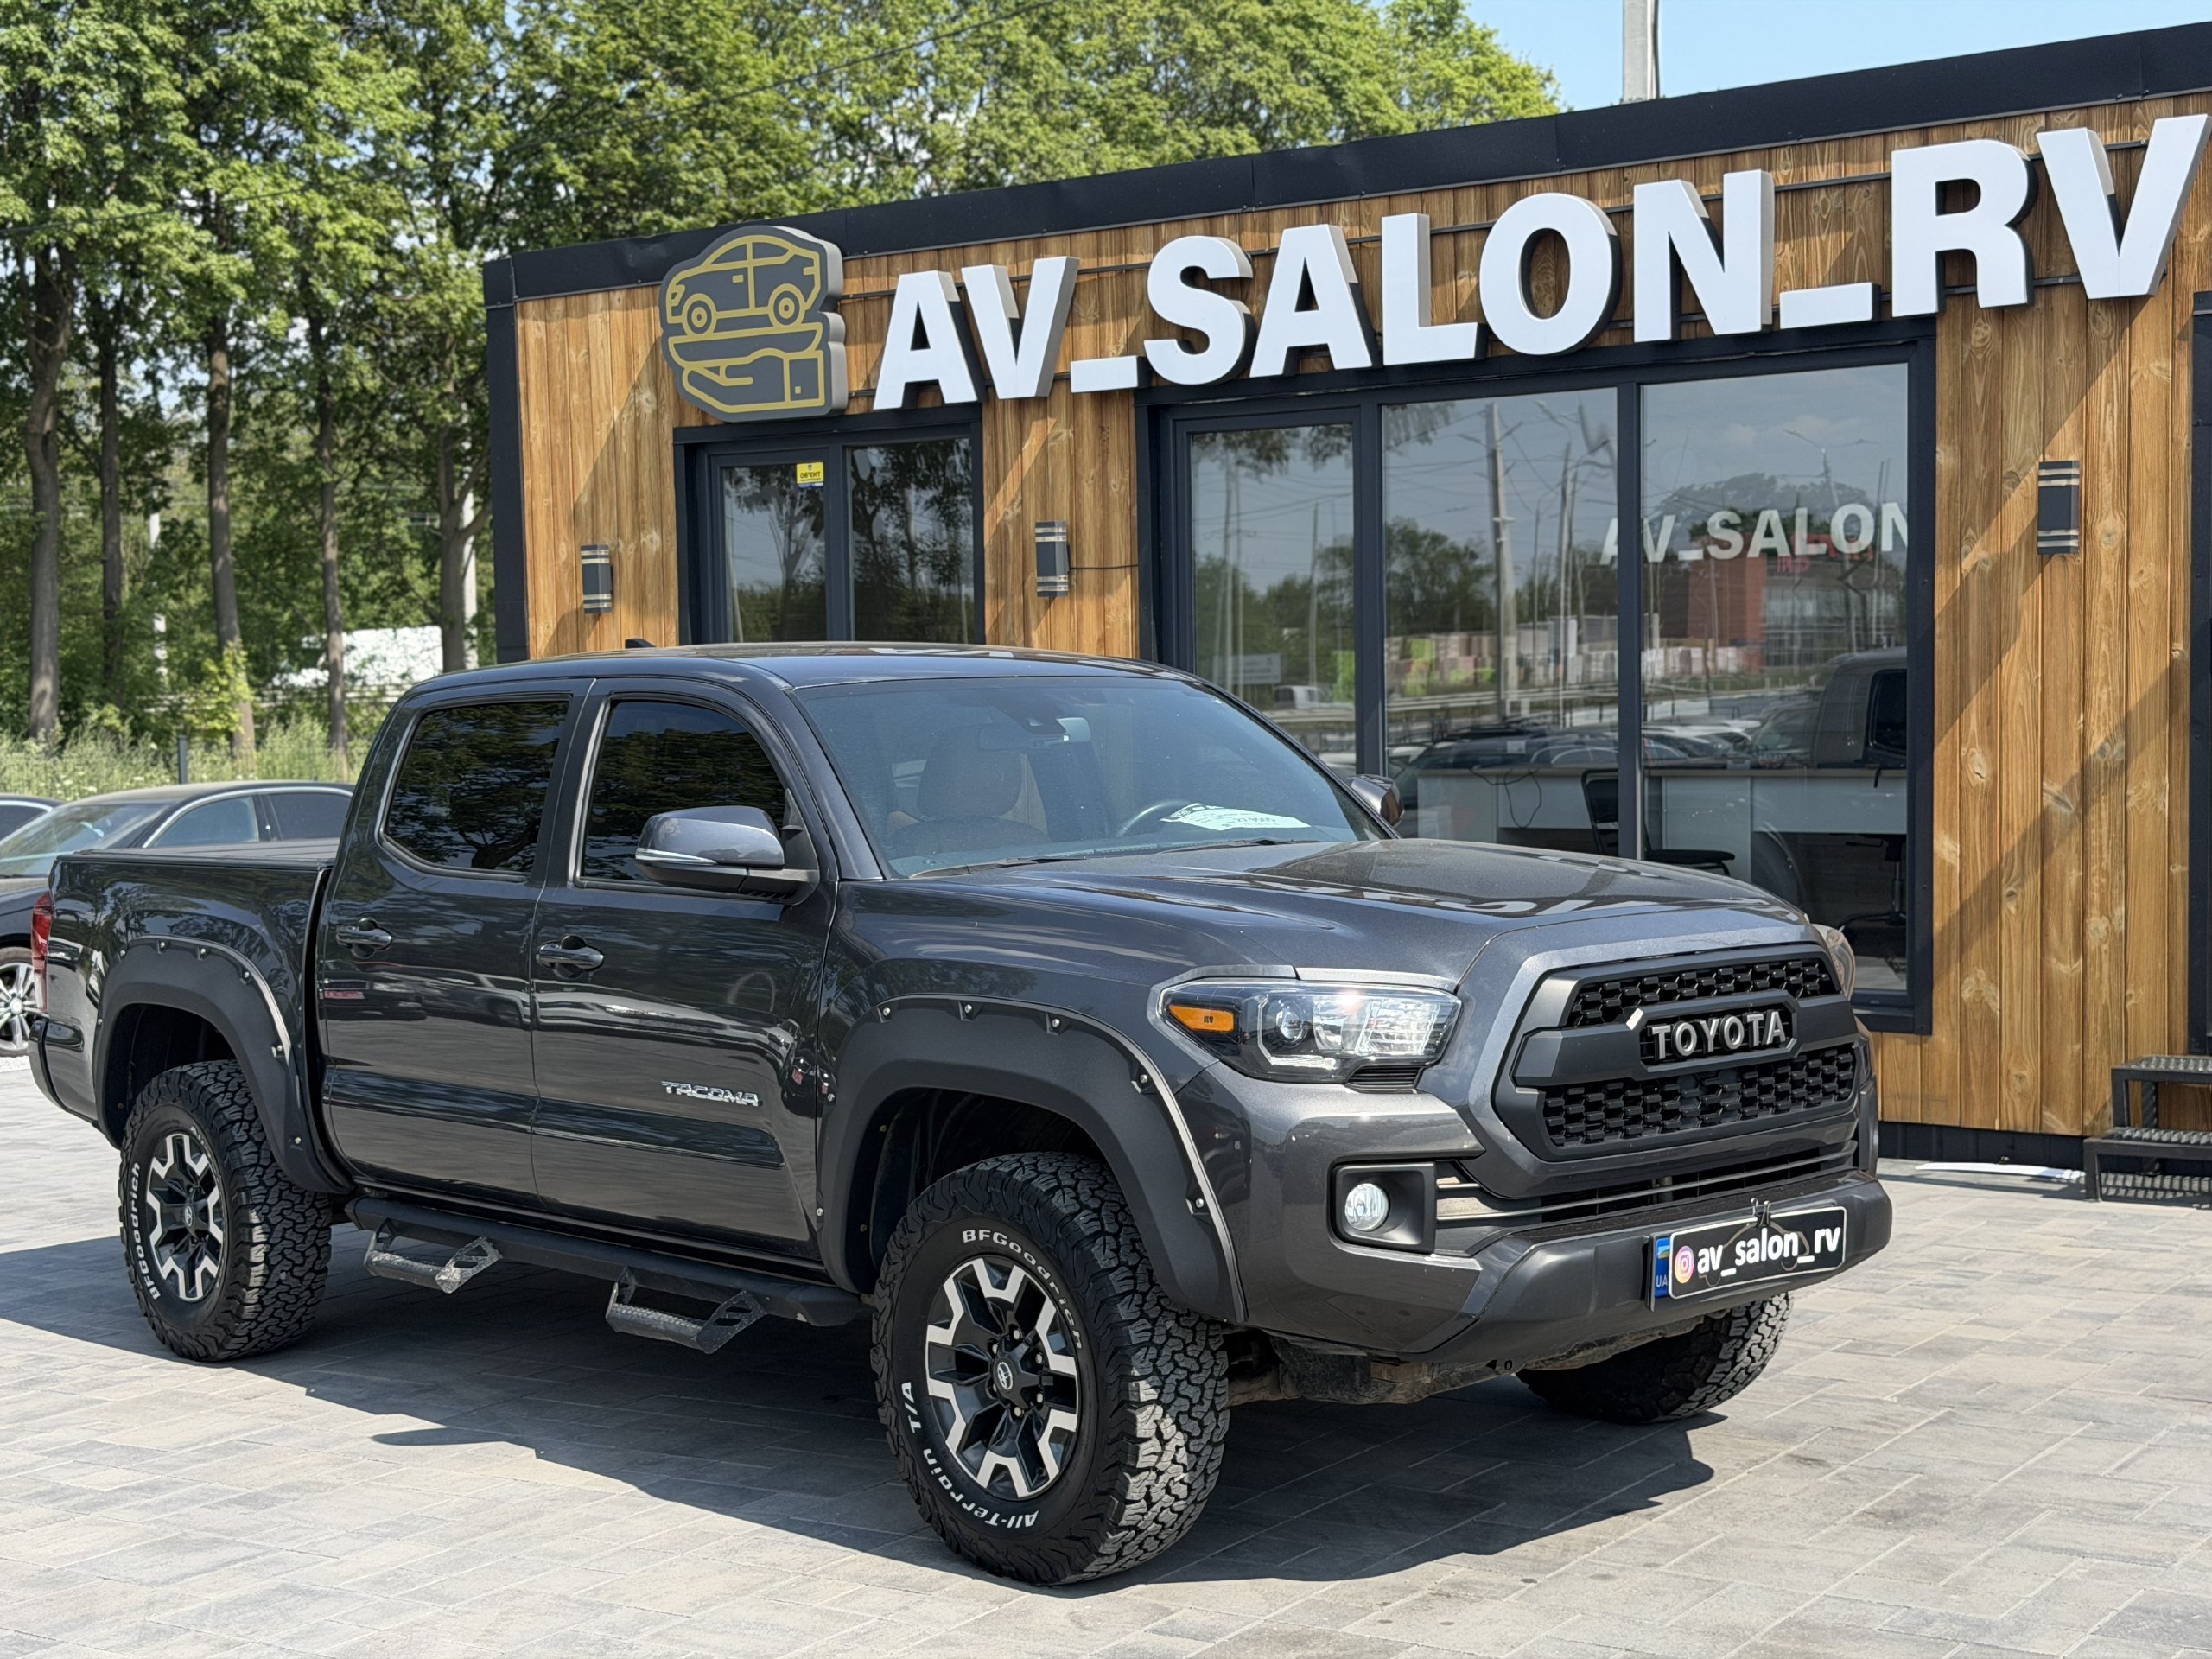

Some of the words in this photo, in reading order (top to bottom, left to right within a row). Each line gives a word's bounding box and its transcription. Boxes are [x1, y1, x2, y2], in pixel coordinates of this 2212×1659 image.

[873, 113, 2210, 410] AV_SALON_RV
[1651, 1010, 1786, 1060] TOYOTA
[661, 1081, 759, 1107] TACOMA
[1697, 1227, 1841, 1277] av_salon_rv
[961, 1229, 1084, 1350] BFGoodrich
[1656, 1274, 1668, 1288] UA
[901, 1382, 922, 1434] T/A
[922, 1447, 1039, 1529] All-Terrain
